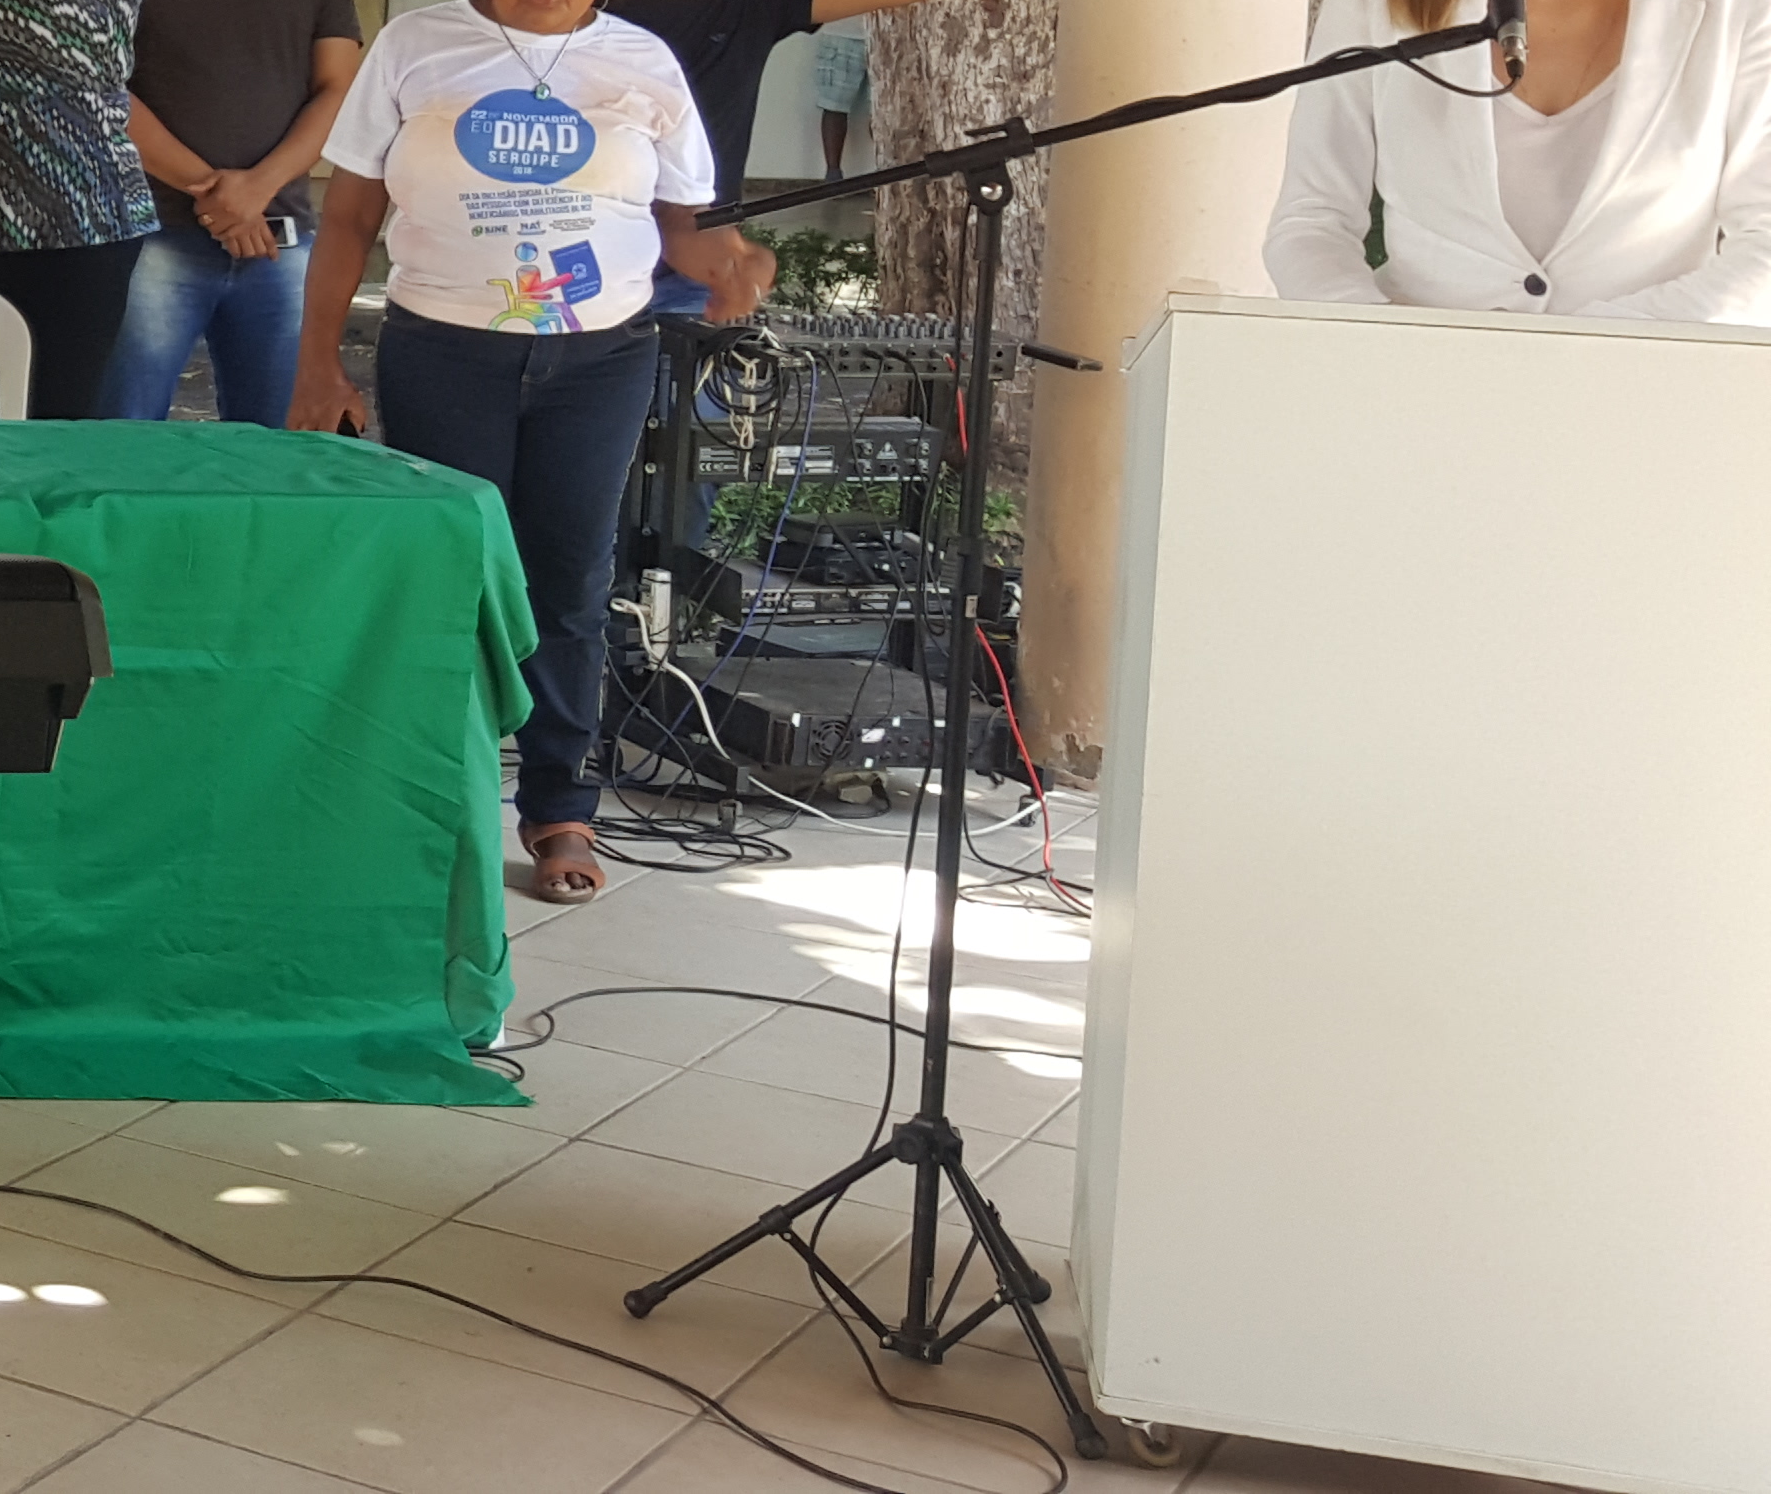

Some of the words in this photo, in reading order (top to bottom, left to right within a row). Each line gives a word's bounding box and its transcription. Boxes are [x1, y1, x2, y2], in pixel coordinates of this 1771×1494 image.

[470, 110, 488, 120] 22
[493, 120, 551, 153] DIA
[556, 124, 579, 154] D
[488, 150, 561, 168] SERGIPE
